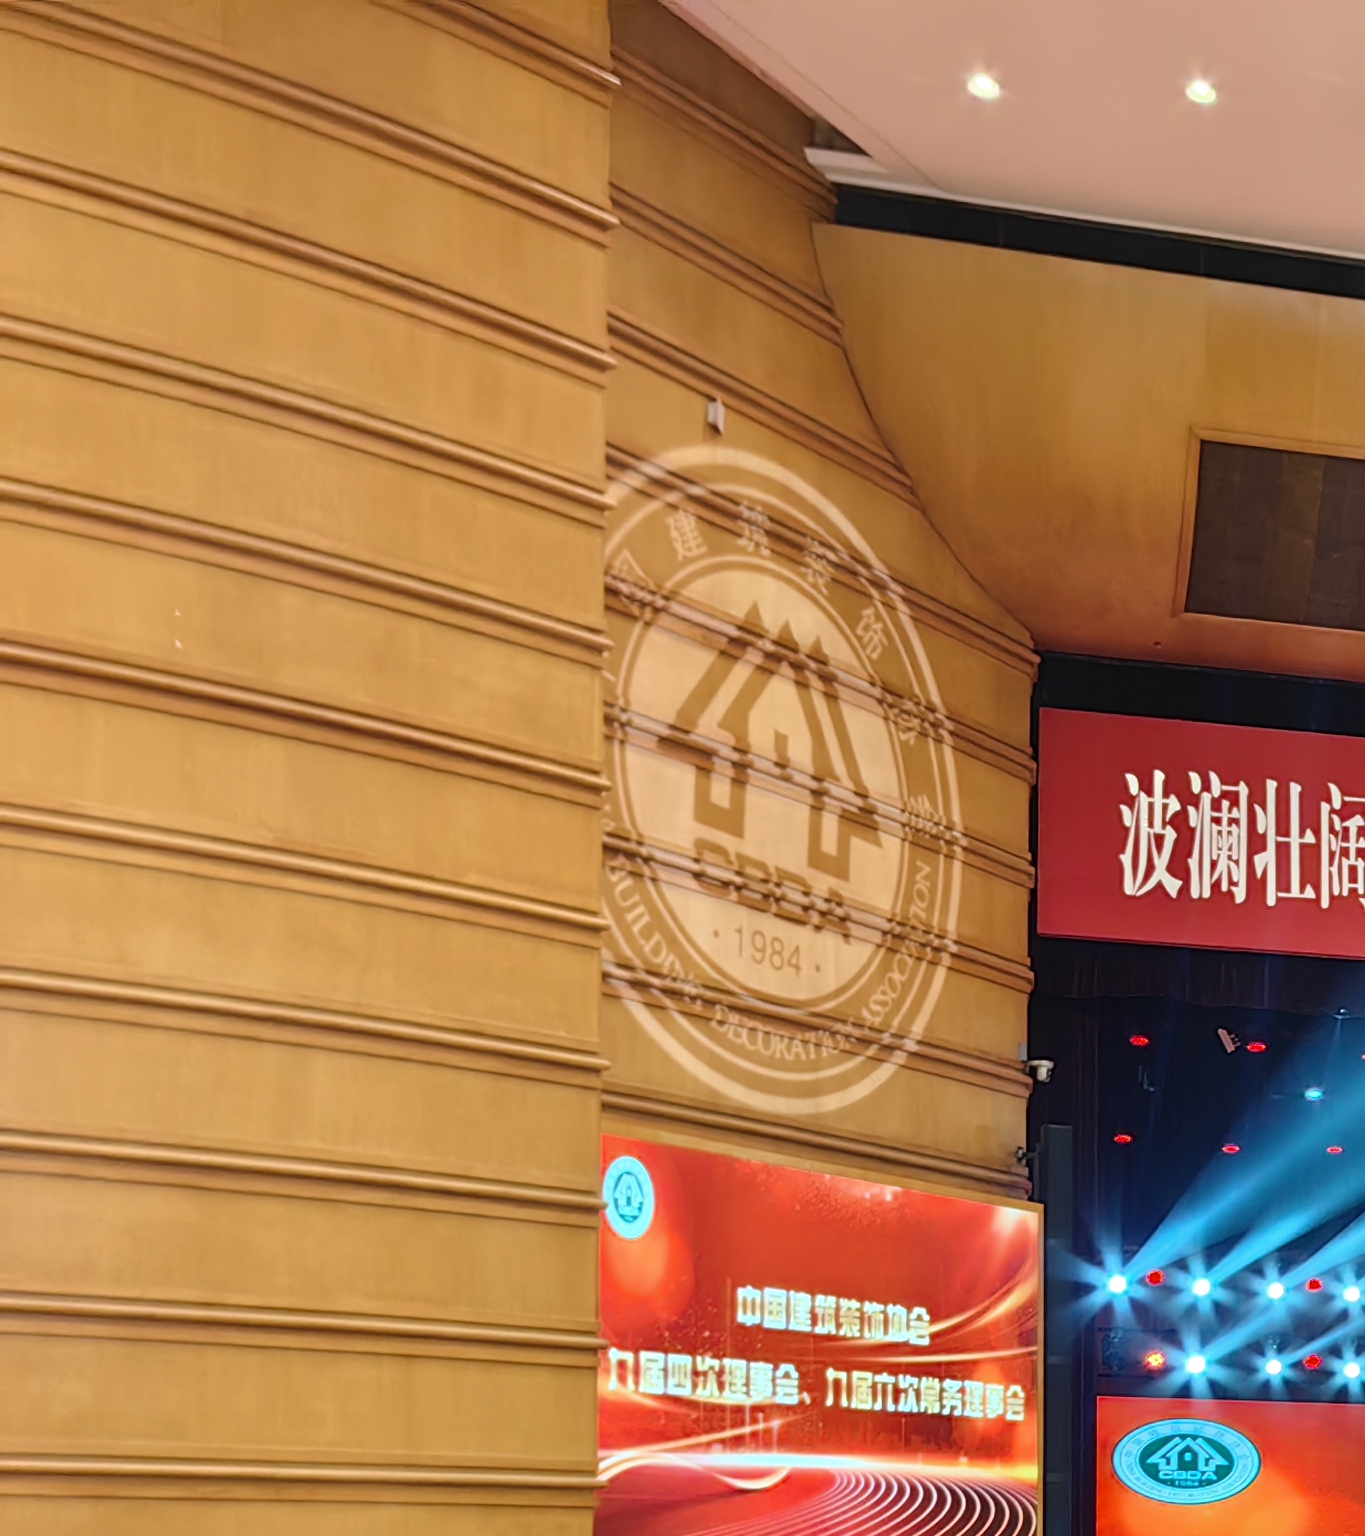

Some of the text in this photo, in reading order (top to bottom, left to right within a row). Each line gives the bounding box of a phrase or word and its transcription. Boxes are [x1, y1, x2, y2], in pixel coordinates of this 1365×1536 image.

[735, 923, 803, 977] 1984
[736, 1285, 931, 1346] 中国建筑装饰协会
[607, 1347, 1026, 1422] 九届四次理事会、九届六次常务理事会
[1158, 1470, 1218, 1481] CBDA
